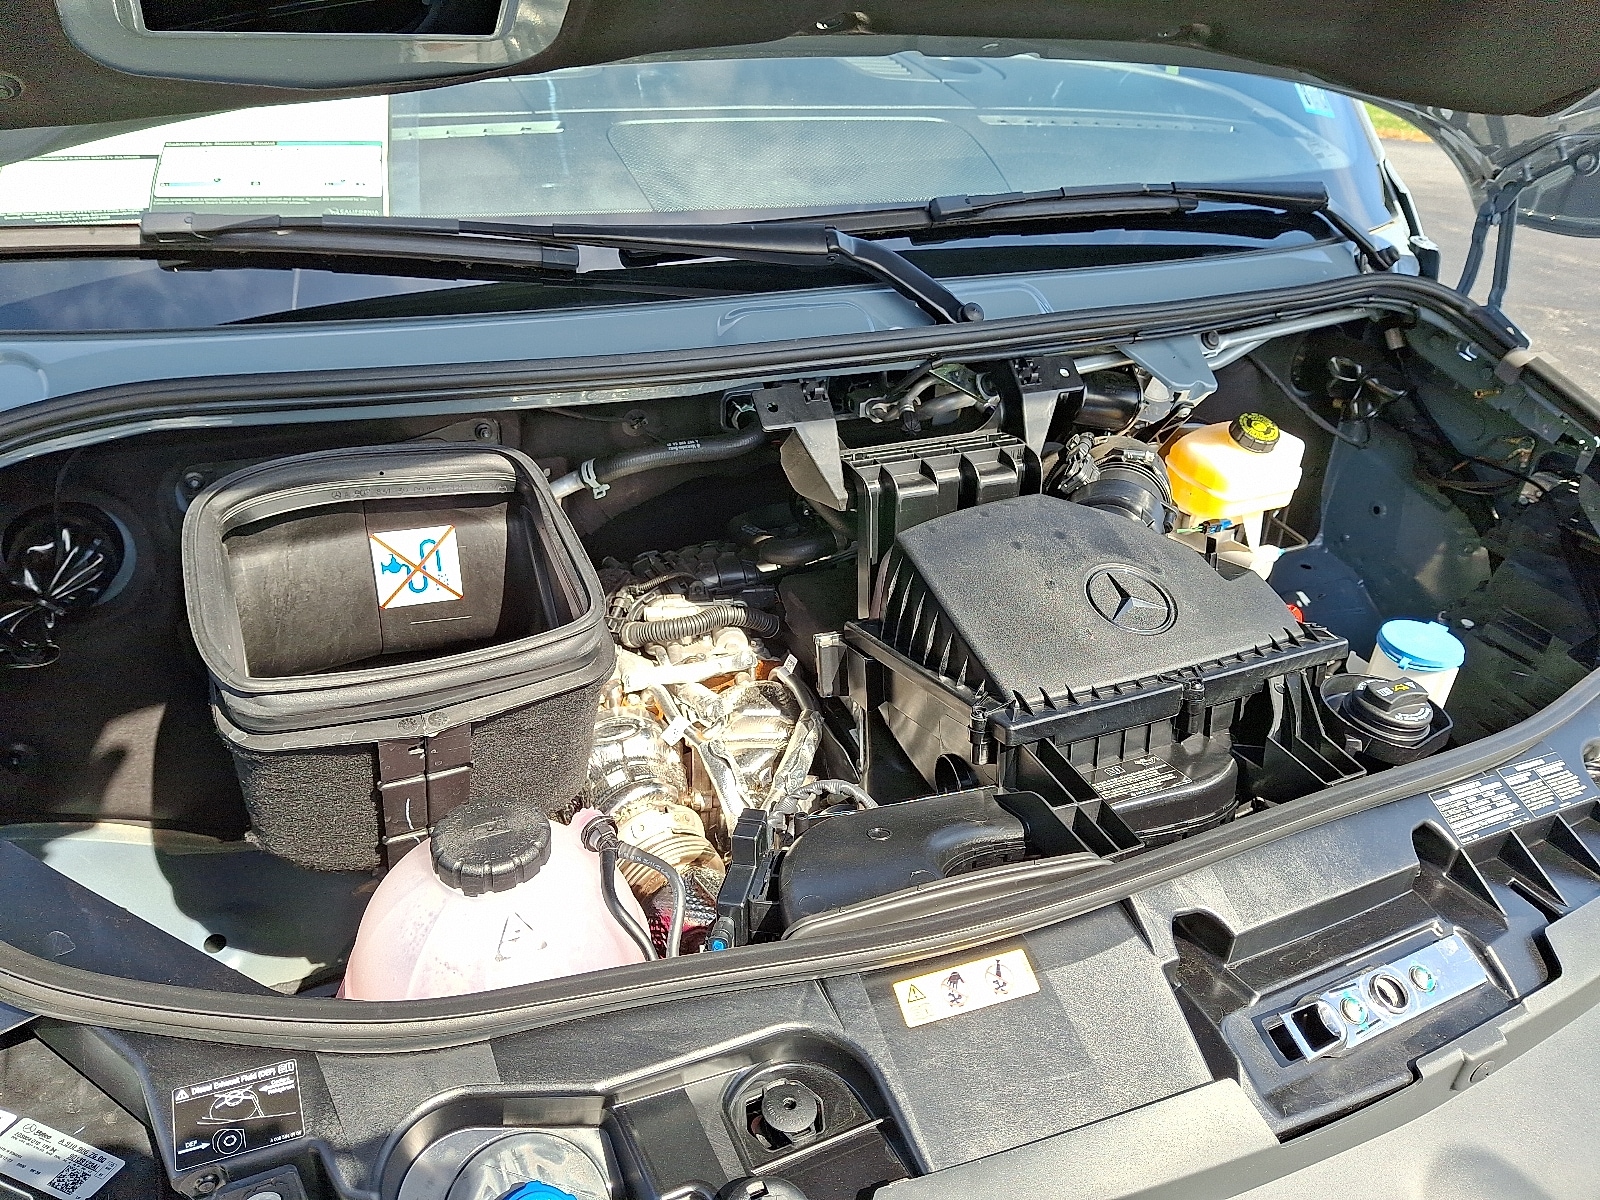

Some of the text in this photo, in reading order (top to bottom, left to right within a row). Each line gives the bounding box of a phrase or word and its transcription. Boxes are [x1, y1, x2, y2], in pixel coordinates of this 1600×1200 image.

[191, 1084, 212, 1095] Diesel
[214, 1077, 241, 1089] Exhaust
[241, 1072, 258, 1083] Fluid
[185, 1140, 198, 1149] DEF
